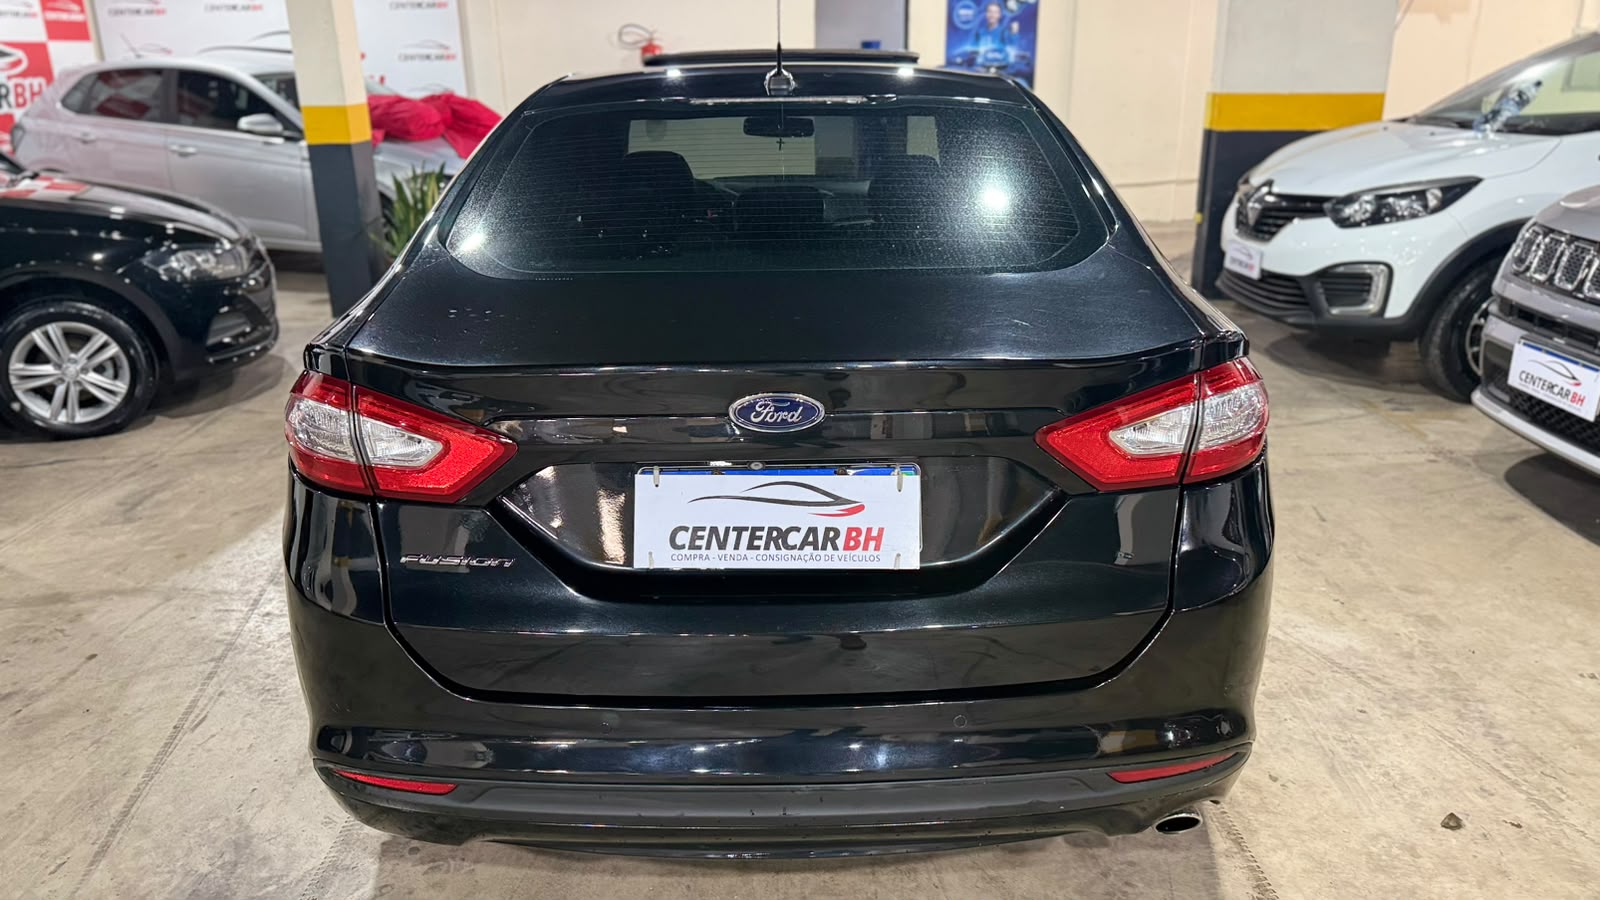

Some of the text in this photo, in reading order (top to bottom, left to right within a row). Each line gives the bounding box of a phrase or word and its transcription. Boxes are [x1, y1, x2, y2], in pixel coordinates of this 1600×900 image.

[750, 400, 804, 422] Ford
[670, 553, 711, 563] COMPRA
[717, 553, 748, 563] VENDA
[755, 552, 822, 564] CONSIGNAÇÃO
[824, 553, 835, 563] DE
[837, 552, 881, 563] VEÍCULOS
